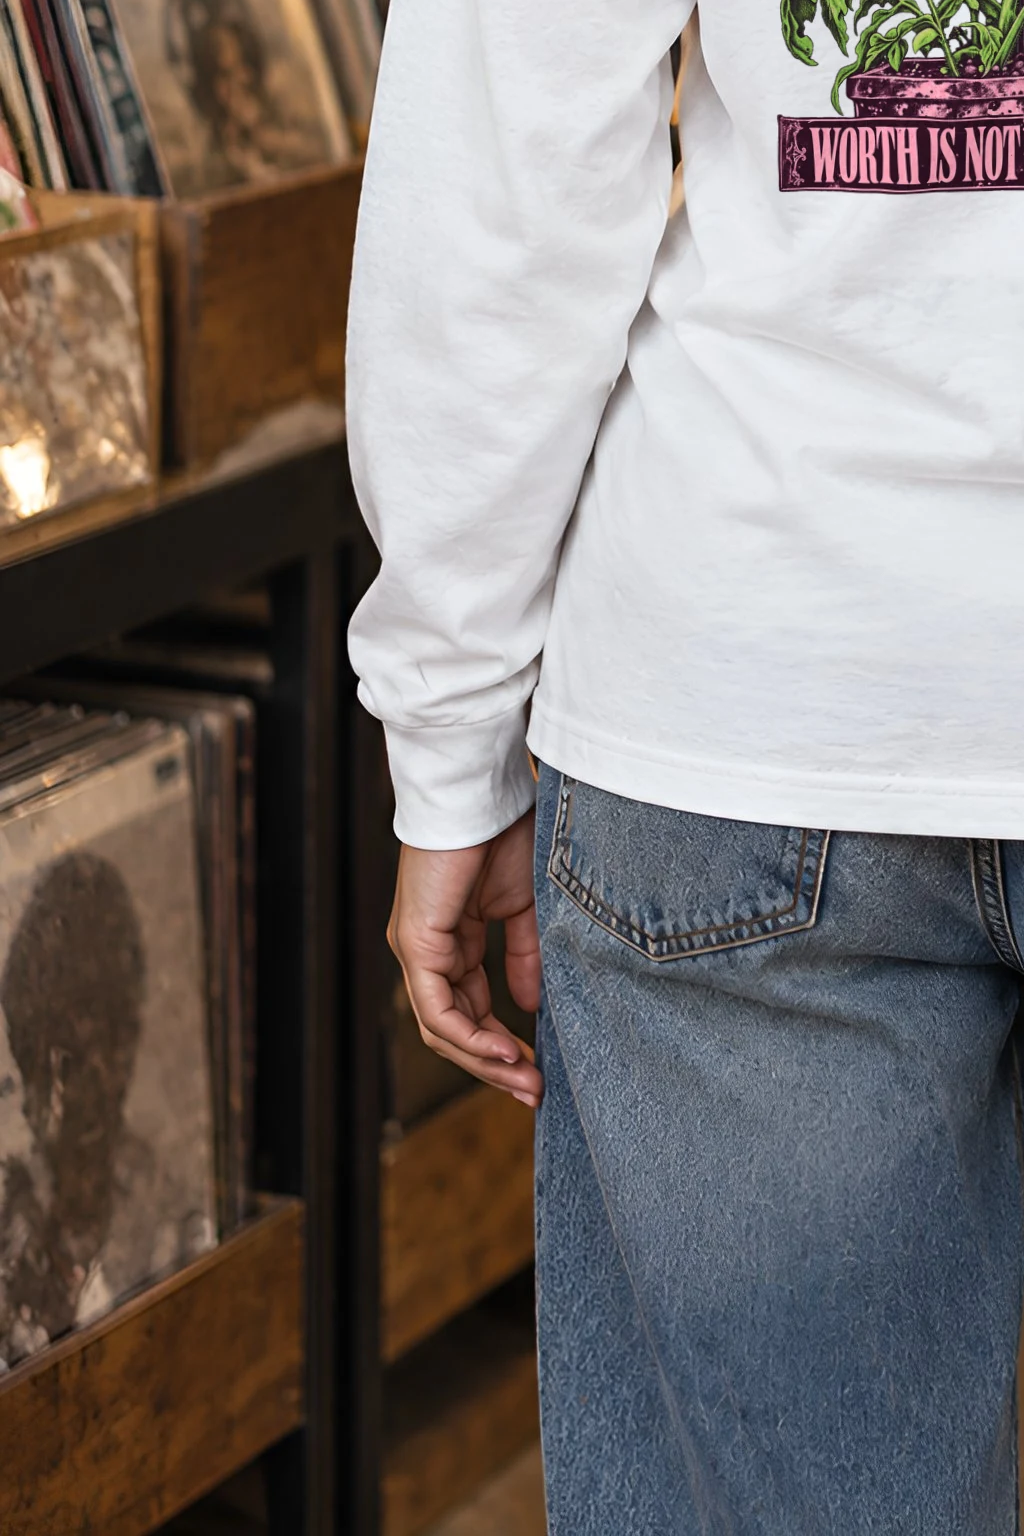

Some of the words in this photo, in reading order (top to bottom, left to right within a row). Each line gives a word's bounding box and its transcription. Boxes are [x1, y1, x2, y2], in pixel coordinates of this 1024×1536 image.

[808, 126, 921, 185] WORTH
[926, 126, 957, 184] IS
[962, 125, 1021, 182] NOT
